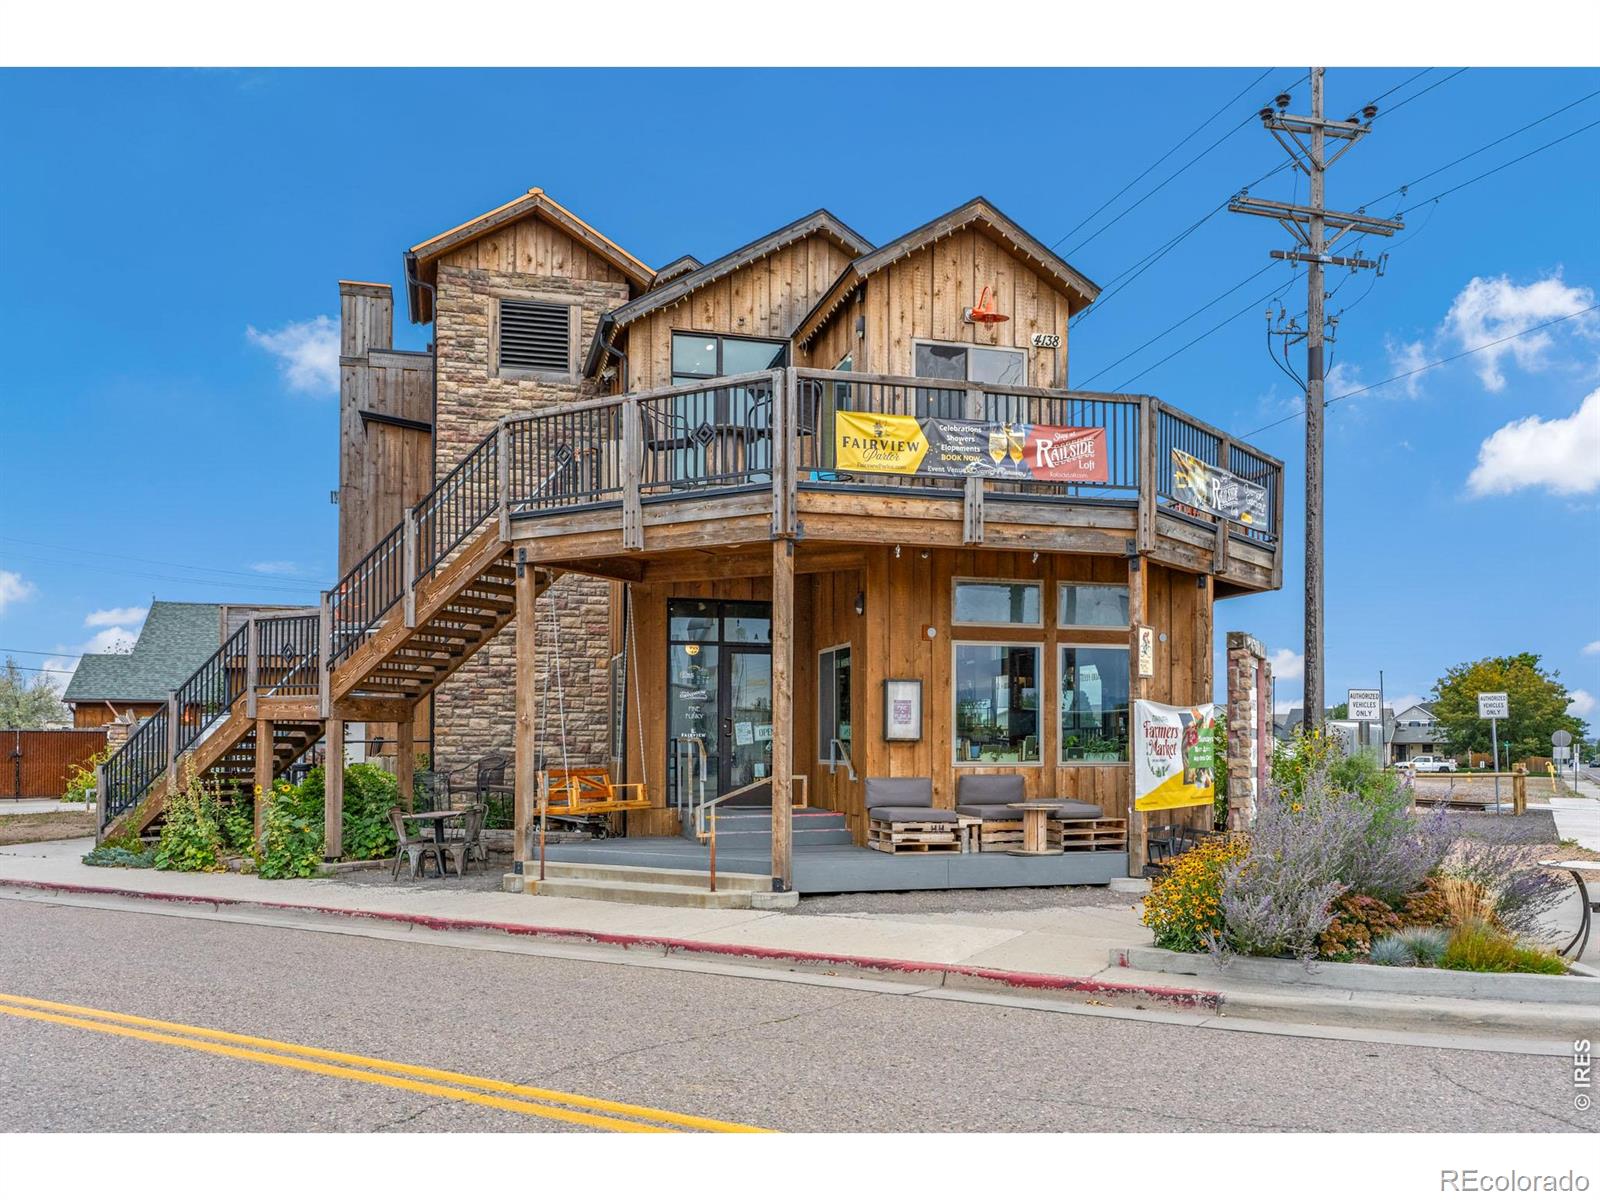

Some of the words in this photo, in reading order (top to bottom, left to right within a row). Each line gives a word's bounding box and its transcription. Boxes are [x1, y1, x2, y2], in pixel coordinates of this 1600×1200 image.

[1034, 335, 1060, 347] 4138
[939, 424, 982, 433] Celebrations
[946, 434, 975, 442] Showers
[842, 435, 920, 452] FAIRVIEW
[940, 443, 981, 453] Elopements
[940, 453, 961, 461] BOOK
[963, 454, 981, 462] NOW
[927, 465, 945, 473] Event
[1079, 460, 1095, 471] Loft
[1143, 720, 1179, 739] Farmers
[1149, 739, 1177, 759] Market
